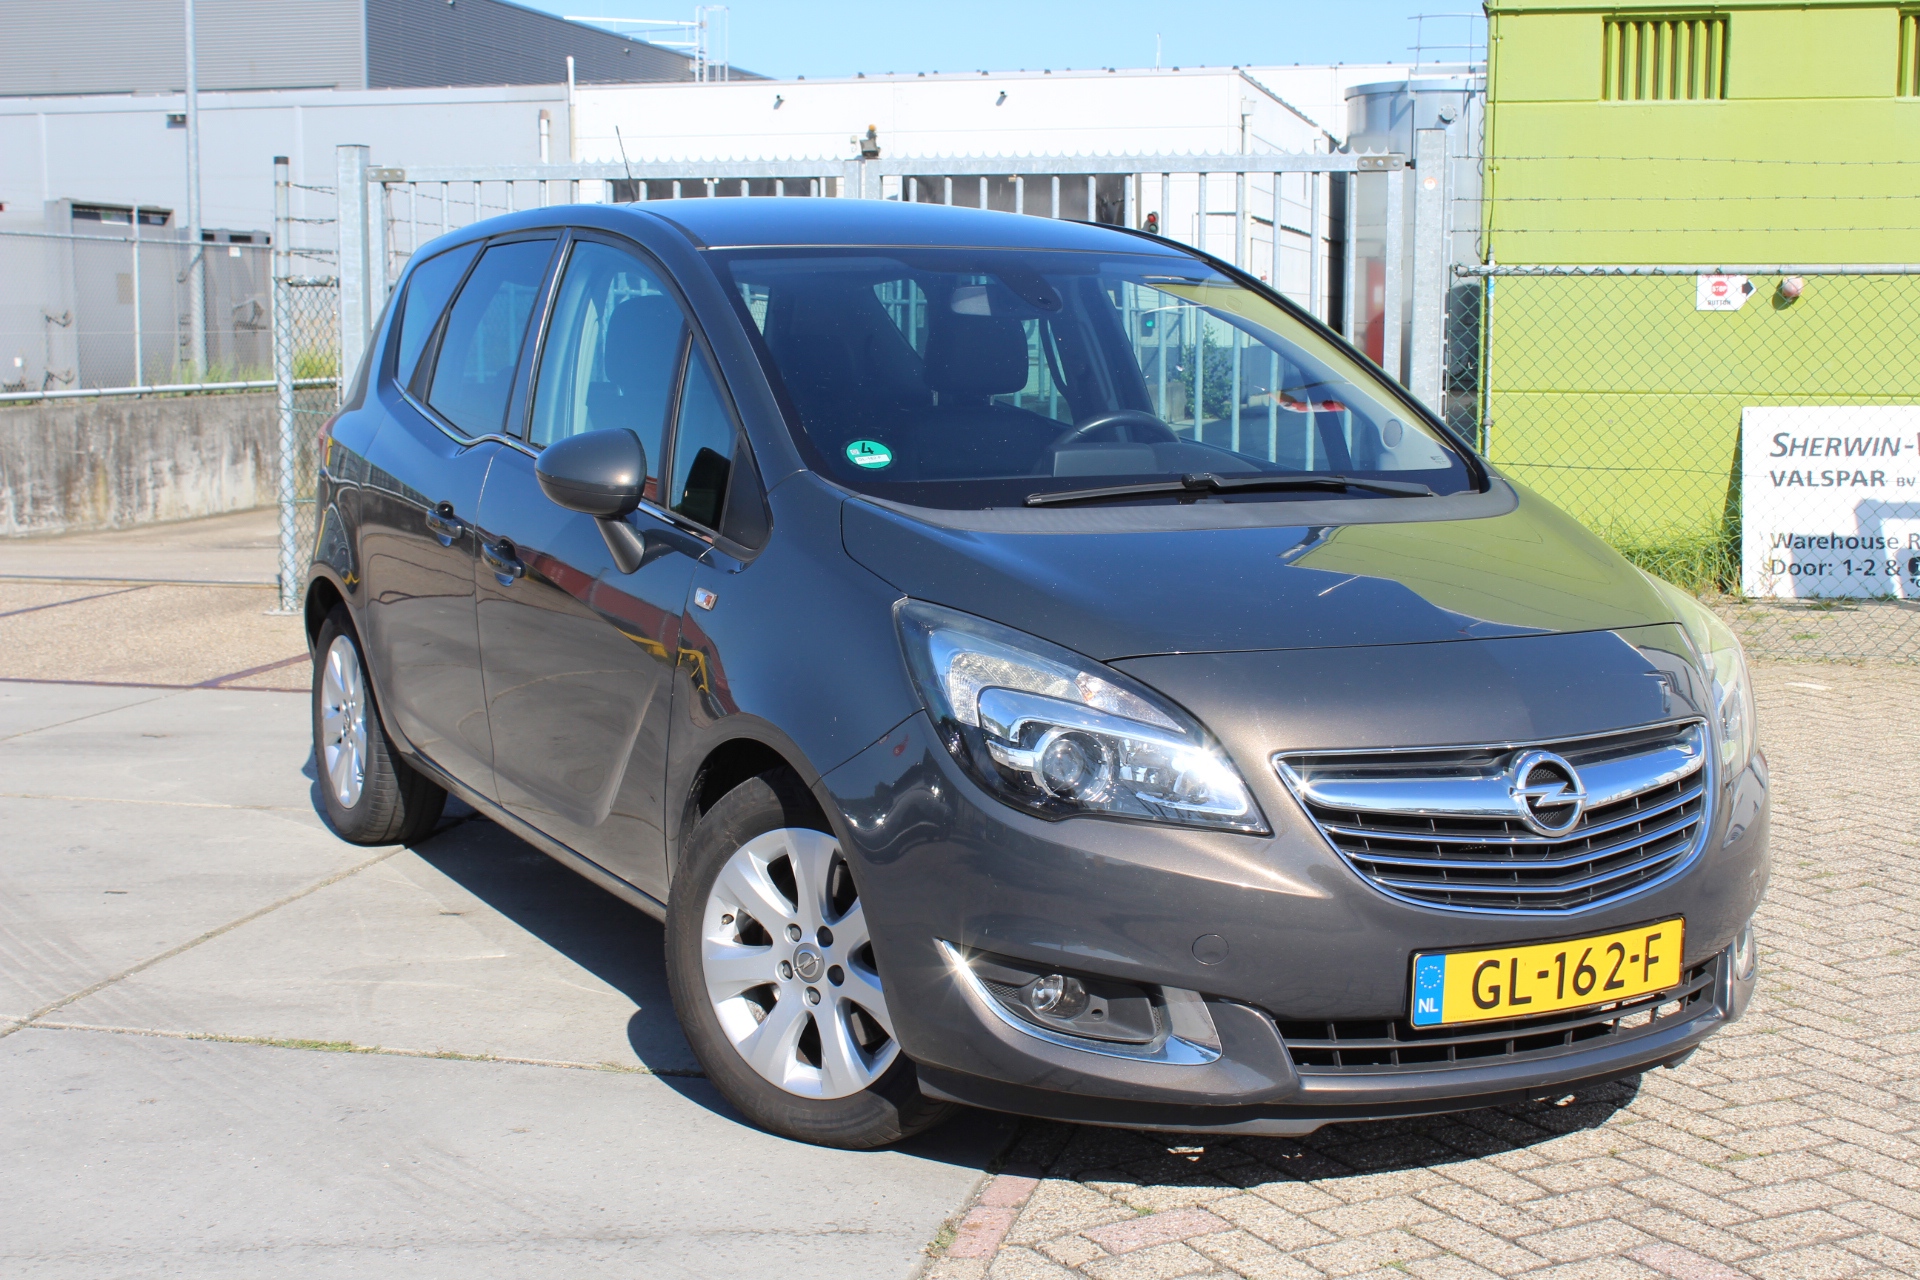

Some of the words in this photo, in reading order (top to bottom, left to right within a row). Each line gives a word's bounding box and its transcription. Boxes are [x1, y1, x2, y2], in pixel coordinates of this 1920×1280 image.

[861, 442, 874, 454] 4
[1769, 432, 1920, 457] SHERWIN-
[1769, 470, 1885, 487] VALSPAR
[1896, 476, 1916, 487] BV
[1770, 531, 1899, 550] Warehouse
[1771, 559, 1833, 576] Door:
[1842, 559, 1876, 576] 1-2
[1885, 559, 1901, 576] &
[1472, 932, 1662, 1010] GL-162-F
[1418, 997, 1439, 1013] NL
